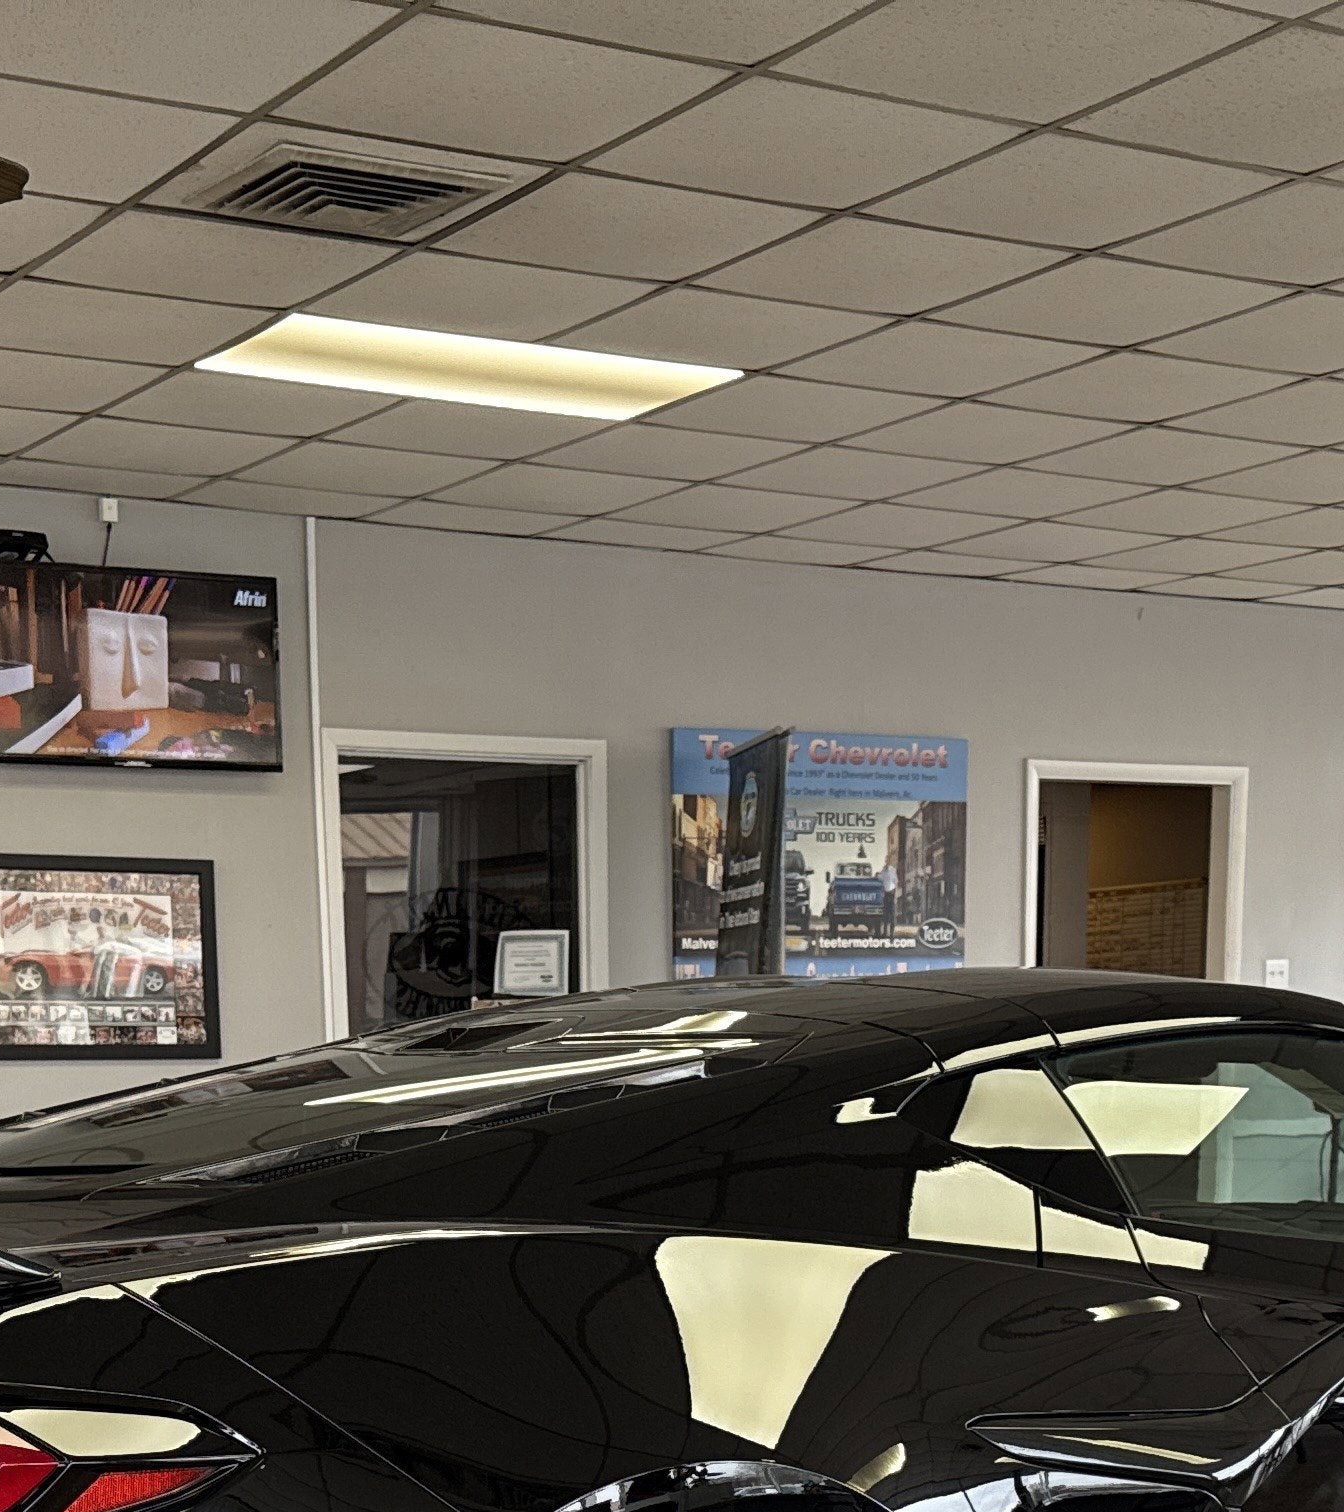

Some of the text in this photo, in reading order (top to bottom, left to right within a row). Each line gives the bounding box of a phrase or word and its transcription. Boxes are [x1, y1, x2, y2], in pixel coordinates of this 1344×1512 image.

[233, 589, 268, 608] Afrin
[809, 738, 949, 769] Chevrolet
[816, 811, 876, 828] TRUCKS
[816, 831, 876, 844] 100 YEARS
[922, 925, 955, 942] Teeter
[681, 937, 719, 950] Malve
[819, 936, 917, 949] teetermotors.com
